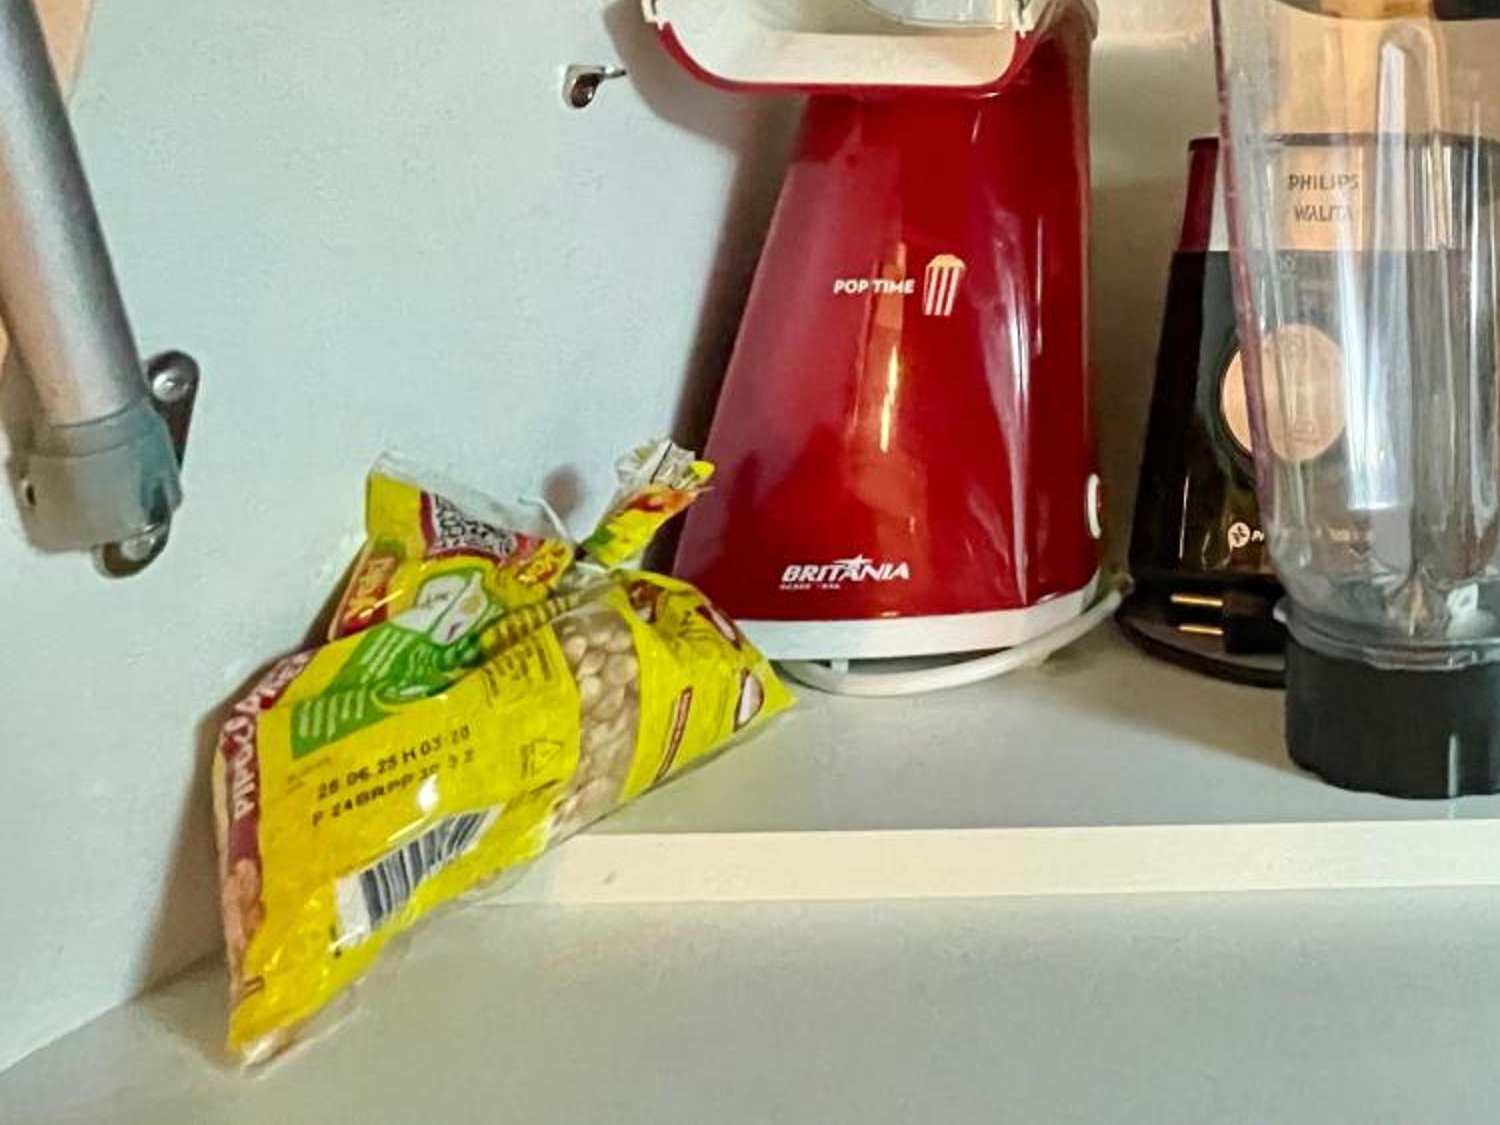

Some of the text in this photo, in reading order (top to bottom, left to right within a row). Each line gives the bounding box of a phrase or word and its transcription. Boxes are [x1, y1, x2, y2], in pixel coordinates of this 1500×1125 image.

[1288, 174, 1359, 191] PHILIPS
[833, 278, 915, 294] POP TIME
